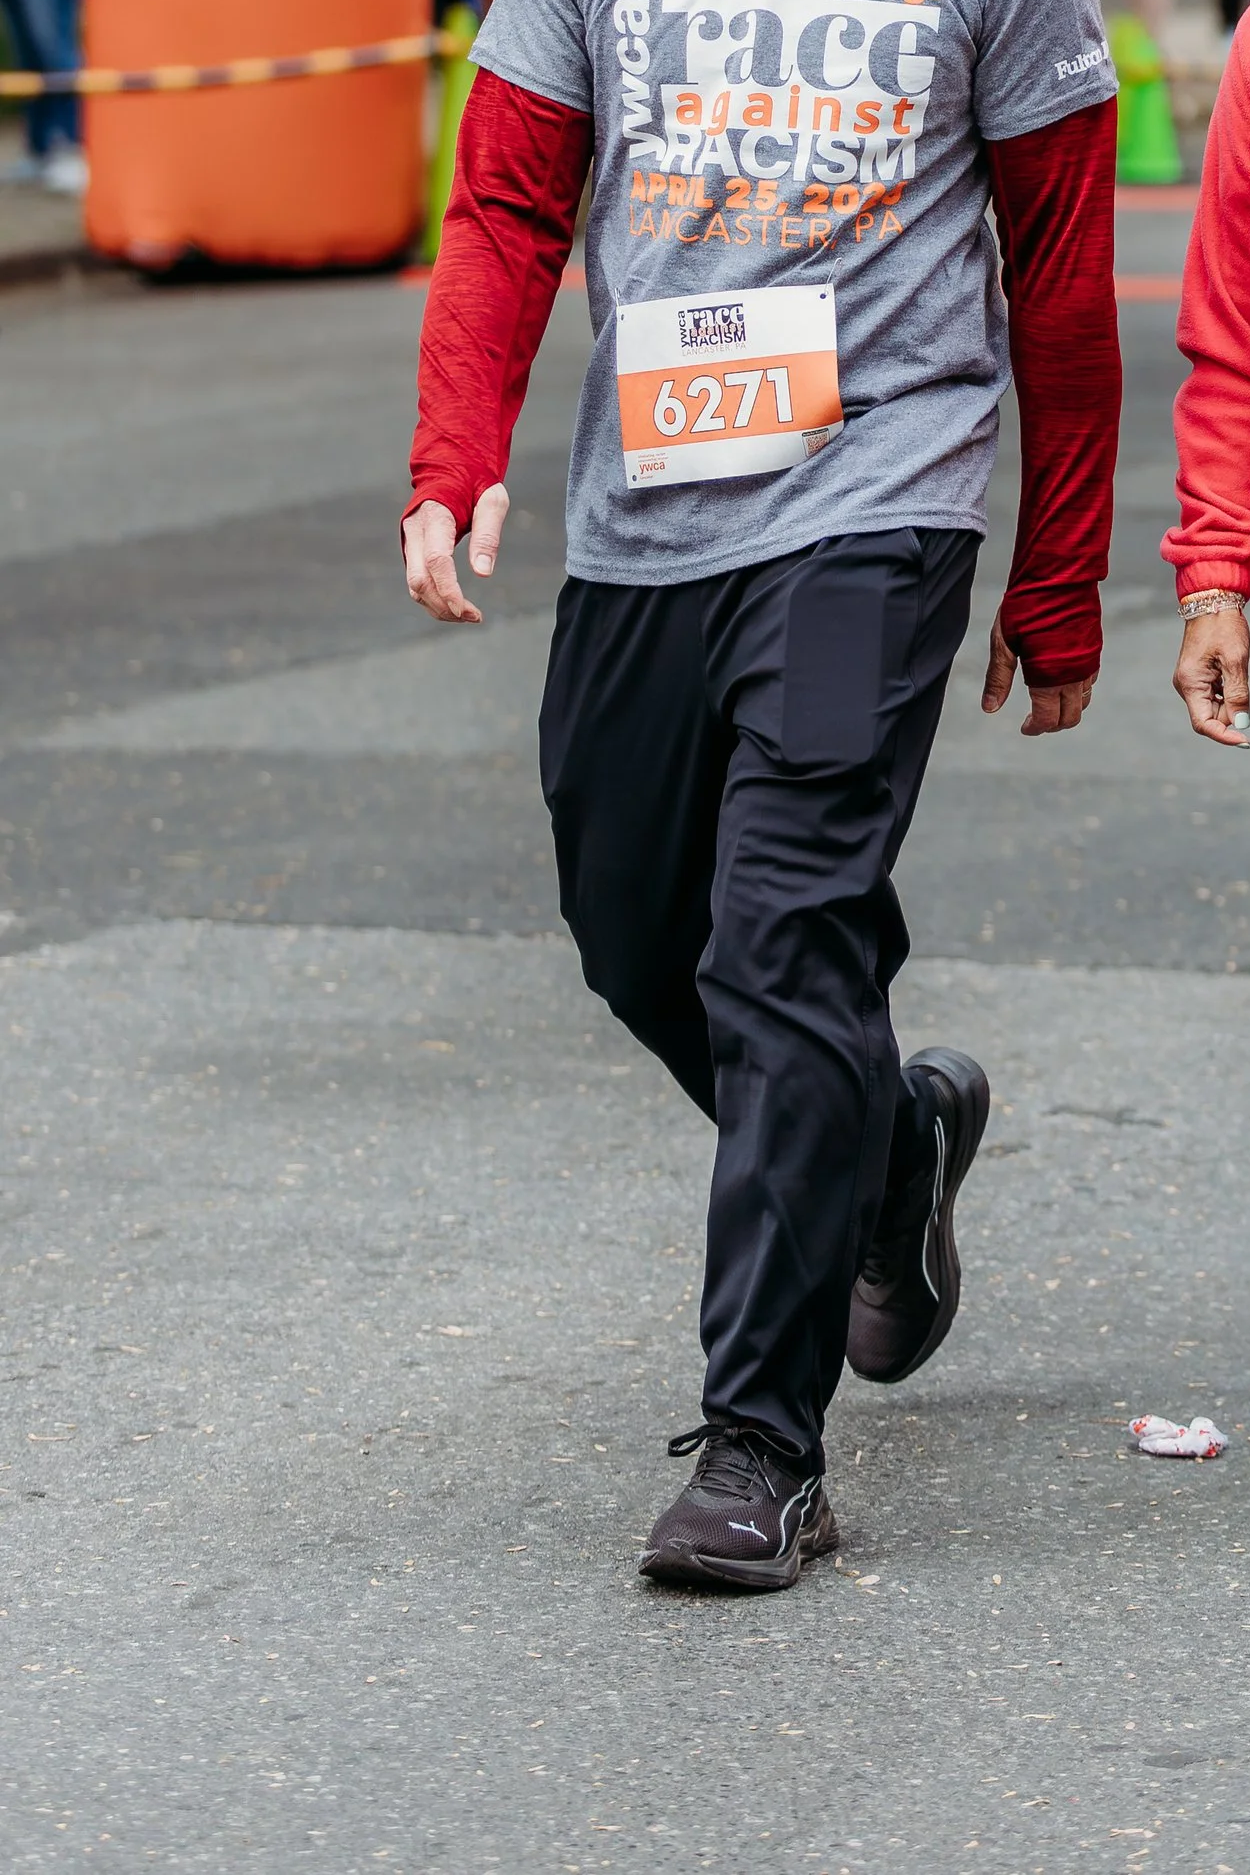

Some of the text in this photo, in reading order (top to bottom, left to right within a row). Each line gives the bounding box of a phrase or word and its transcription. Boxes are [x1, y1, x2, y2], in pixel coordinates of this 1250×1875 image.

[661, 5, 940, 98] race
[675, 84, 915, 136] against
[659, 129, 917, 183] RACISM
[629, 170, 714, 208] APRIL
[725, 180, 788, 216] 25,
[629, 205, 904, 250] LANCASTER, PA
[677, 310, 690, 348] ywca
[687, 305, 745, 327] race
[690, 328, 746, 348] RACISM
[735, 342, 746, 350] PA
[653, 366, 793, 437] 6271
[639, 461, 666, 475] ywca
